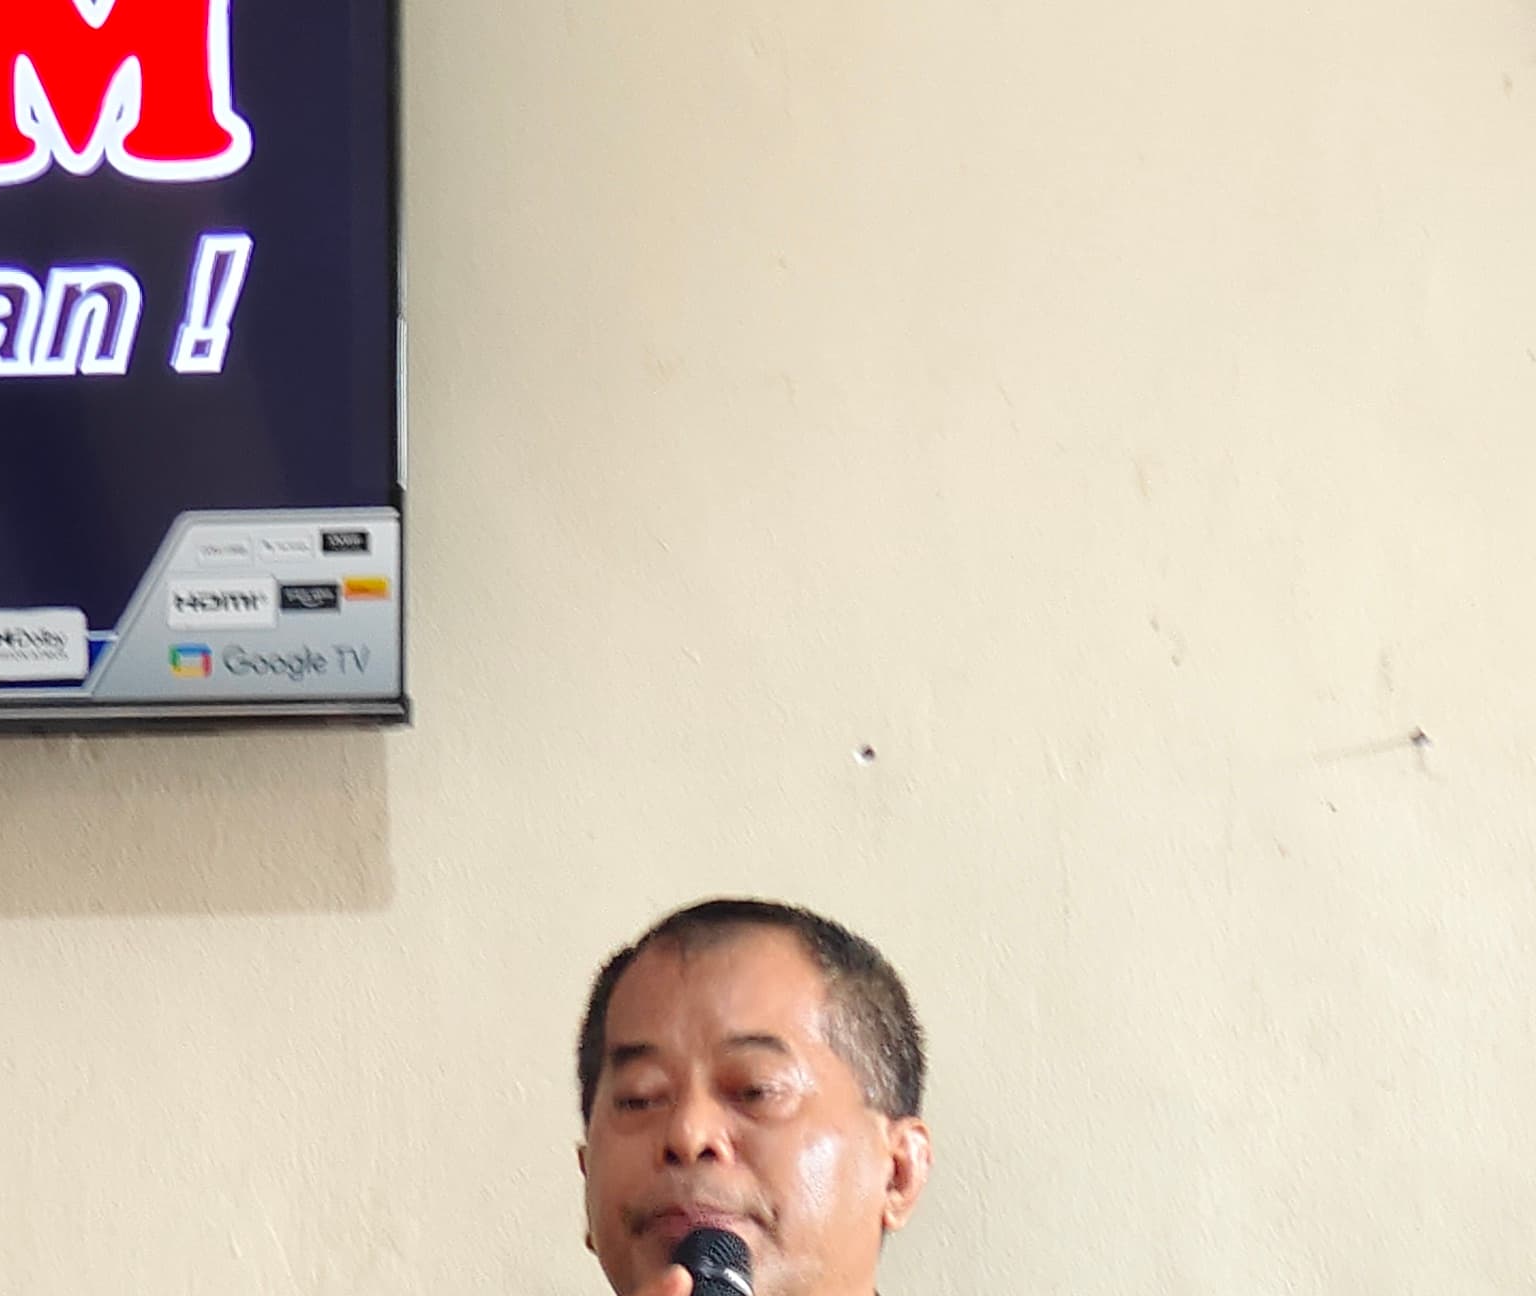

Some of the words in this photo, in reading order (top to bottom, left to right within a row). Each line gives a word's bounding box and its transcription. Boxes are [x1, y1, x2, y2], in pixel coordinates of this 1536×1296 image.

[171, 233, 252, 375] !
[222, 643, 328, 682] Google
[332, 643, 371, 674] TV
